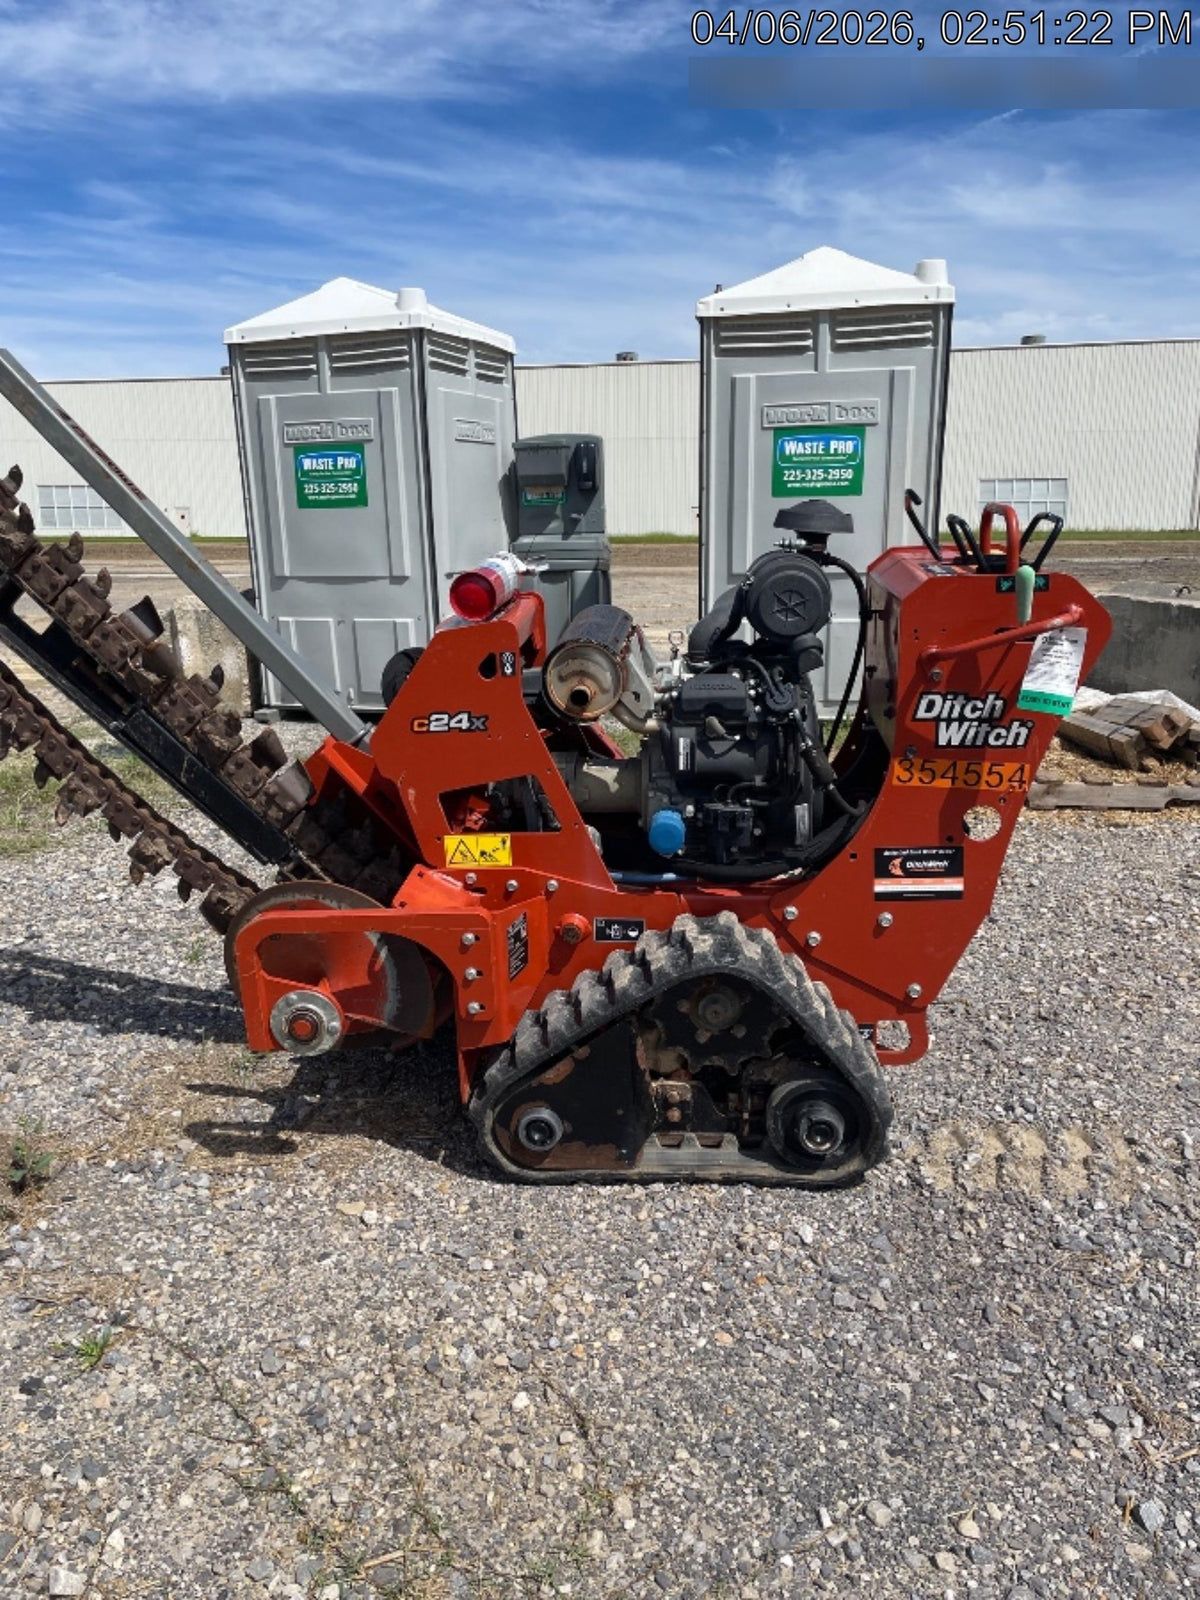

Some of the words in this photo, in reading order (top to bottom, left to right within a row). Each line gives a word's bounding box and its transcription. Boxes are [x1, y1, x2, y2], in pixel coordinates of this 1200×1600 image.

[834, 404, 876, 420] box
[783, 440, 825, 456] WASTE
[829, 440, 854, 455] PRO
[301, 457, 335, 471] WASTE
[782, 469, 854, 482] 225-325-2950
[914, 692, 1005, 720] Ditch
[937, 720, 1030, 747] Witch
[895, 757, 1027, 790] 354554
